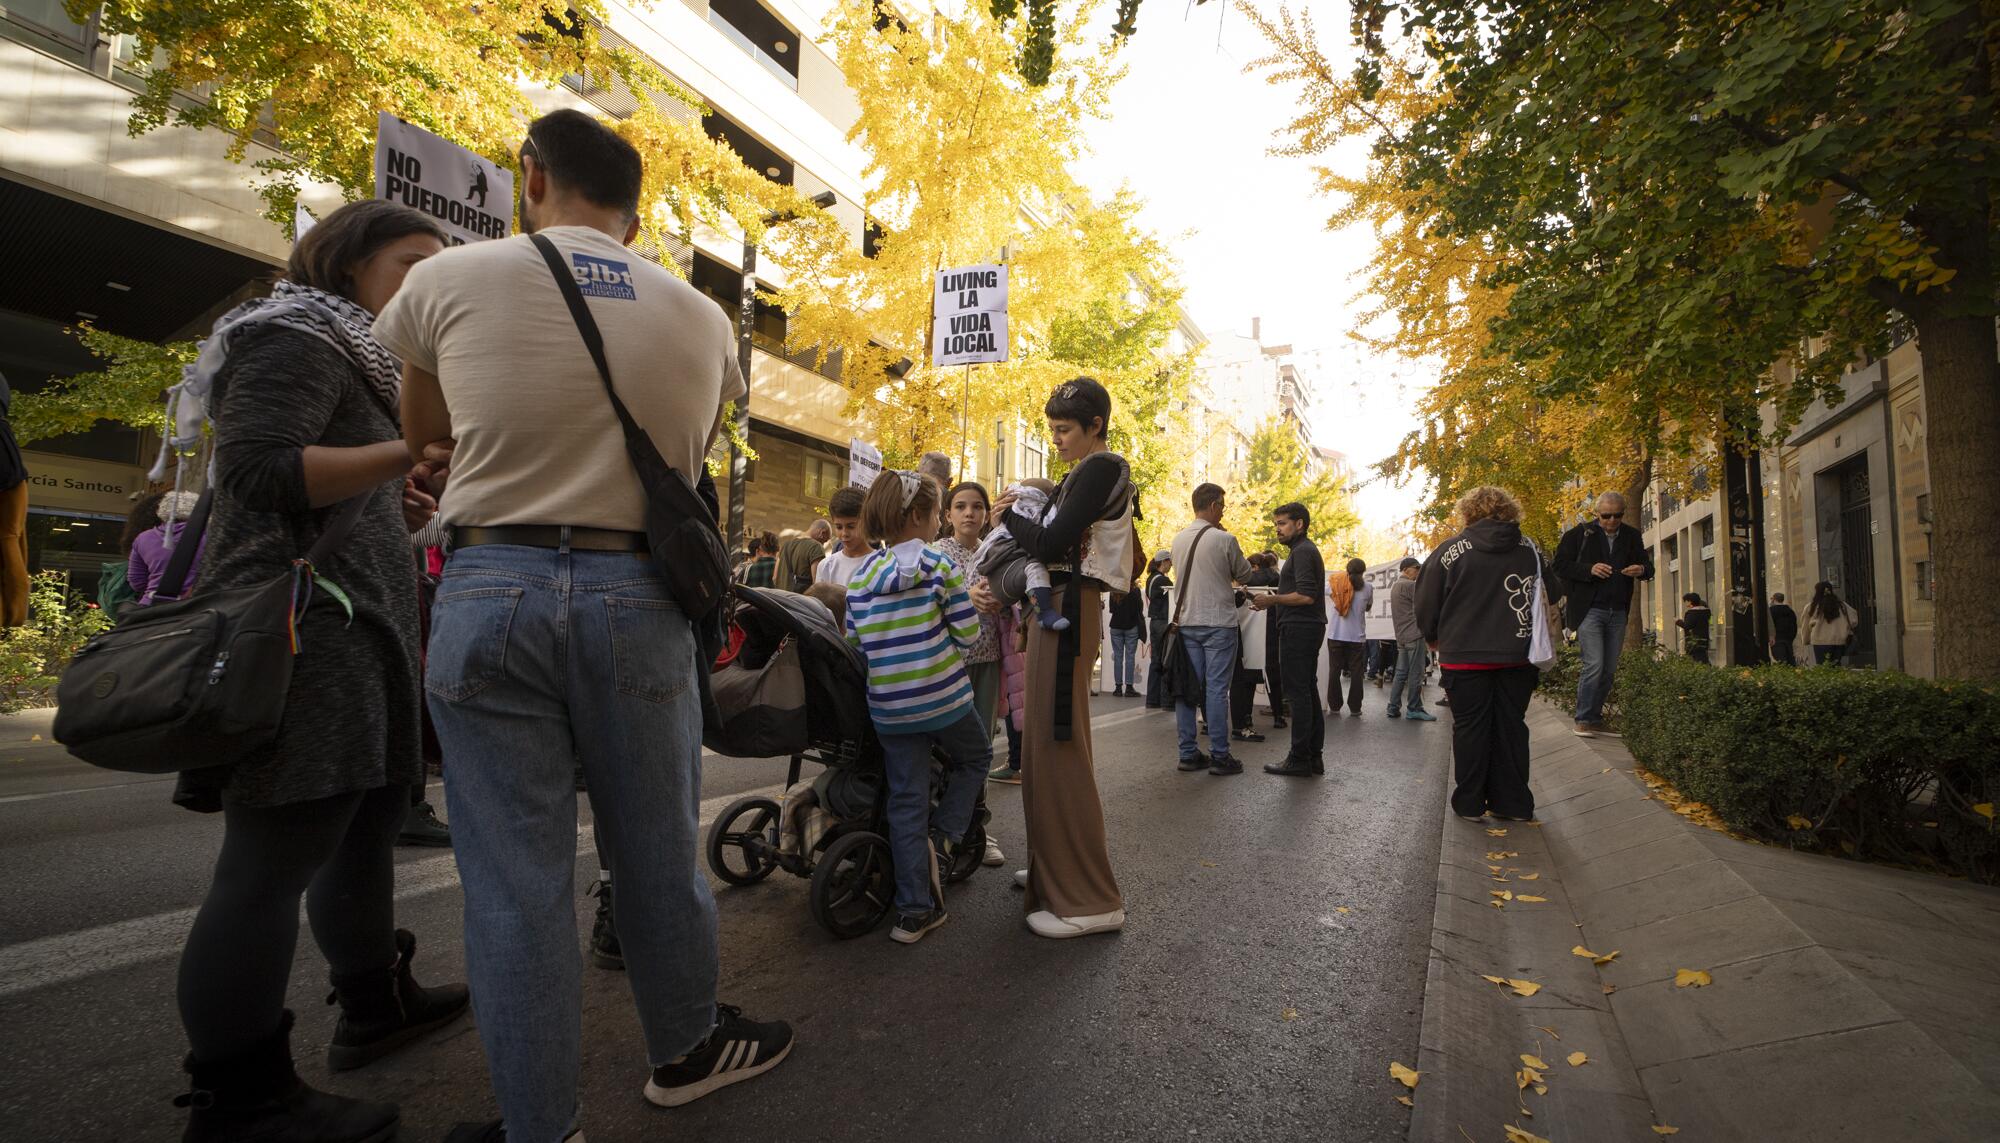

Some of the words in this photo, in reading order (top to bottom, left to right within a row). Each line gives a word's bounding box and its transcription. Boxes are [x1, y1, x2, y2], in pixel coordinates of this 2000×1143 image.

[388, 148, 421, 184] NO
[385, 174, 506, 240] PUEDORRR
[575, 262, 632, 286] glbt
[943, 271, 997, 293] LIVING
[580, 287, 633, 299] museum
[592, 281, 632, 295] history
[959, 290, 979, 309] LA
[950, 313, 991, 335] VIDA
[944, 333, 998, 355] LOCAL
[64, 478, 122, 494] Santos
